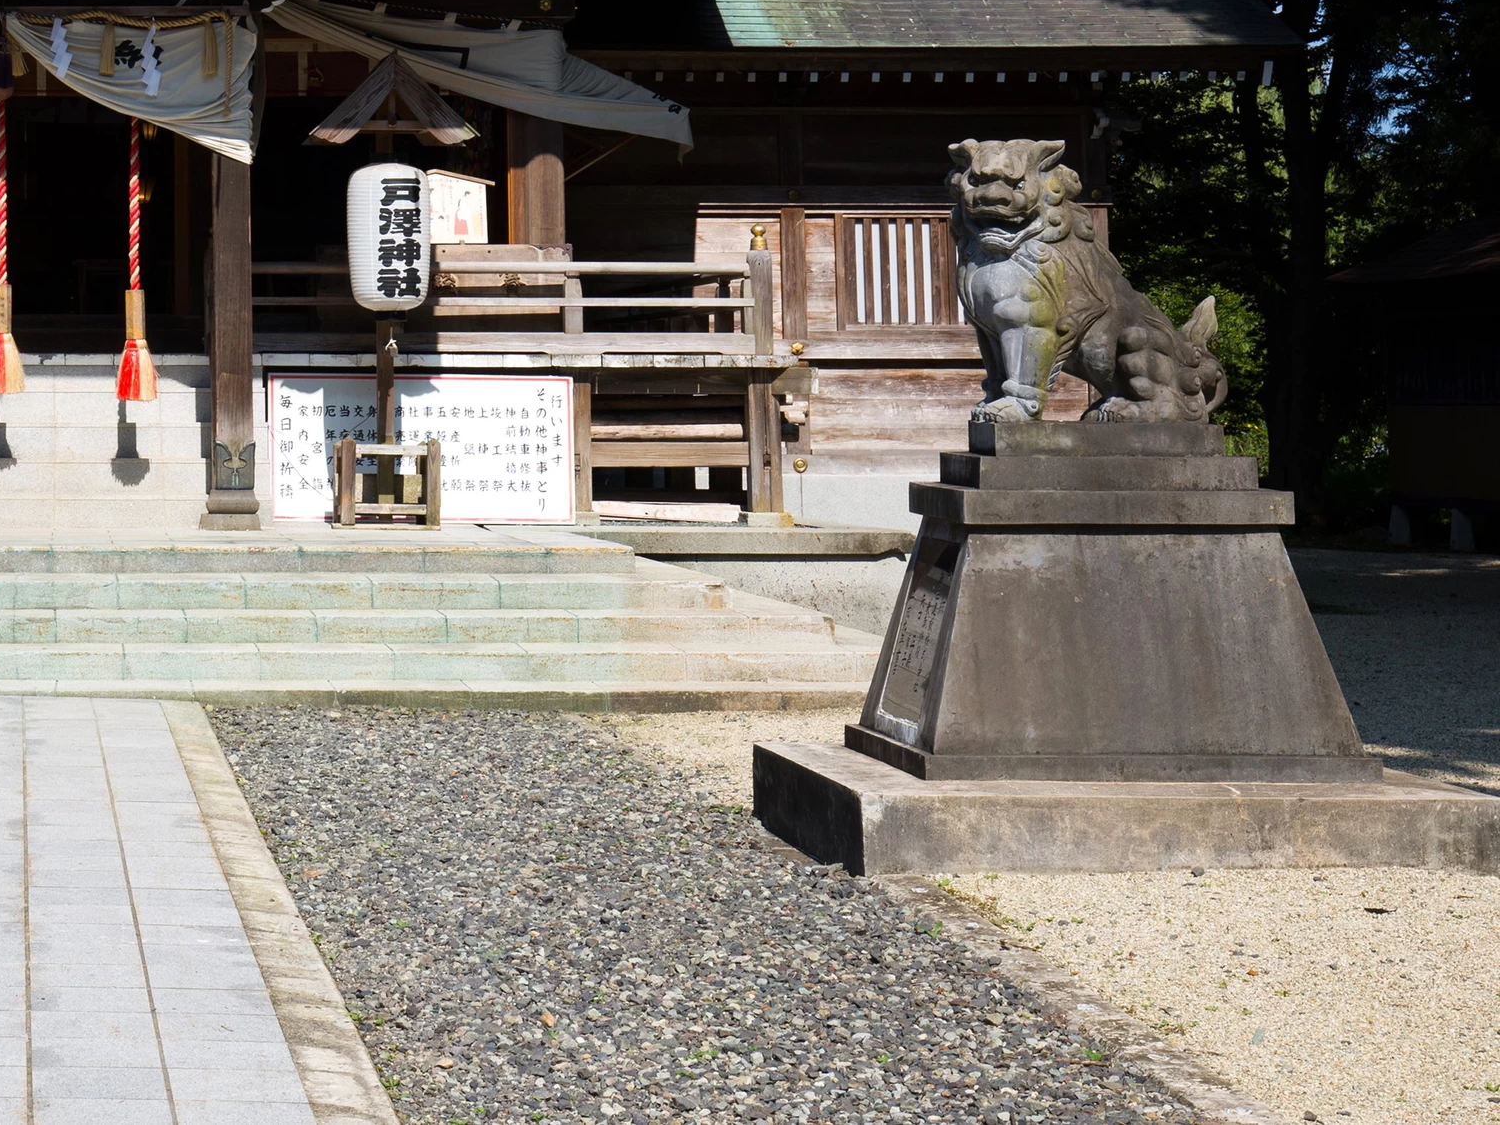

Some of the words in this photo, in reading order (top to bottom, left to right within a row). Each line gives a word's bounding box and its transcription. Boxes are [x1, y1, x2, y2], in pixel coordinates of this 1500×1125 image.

[376, 177, 422, 298] 戸澤神社
[298, 405, 310, 490] 家内安全
[550, 395, 563, 467] 行います
